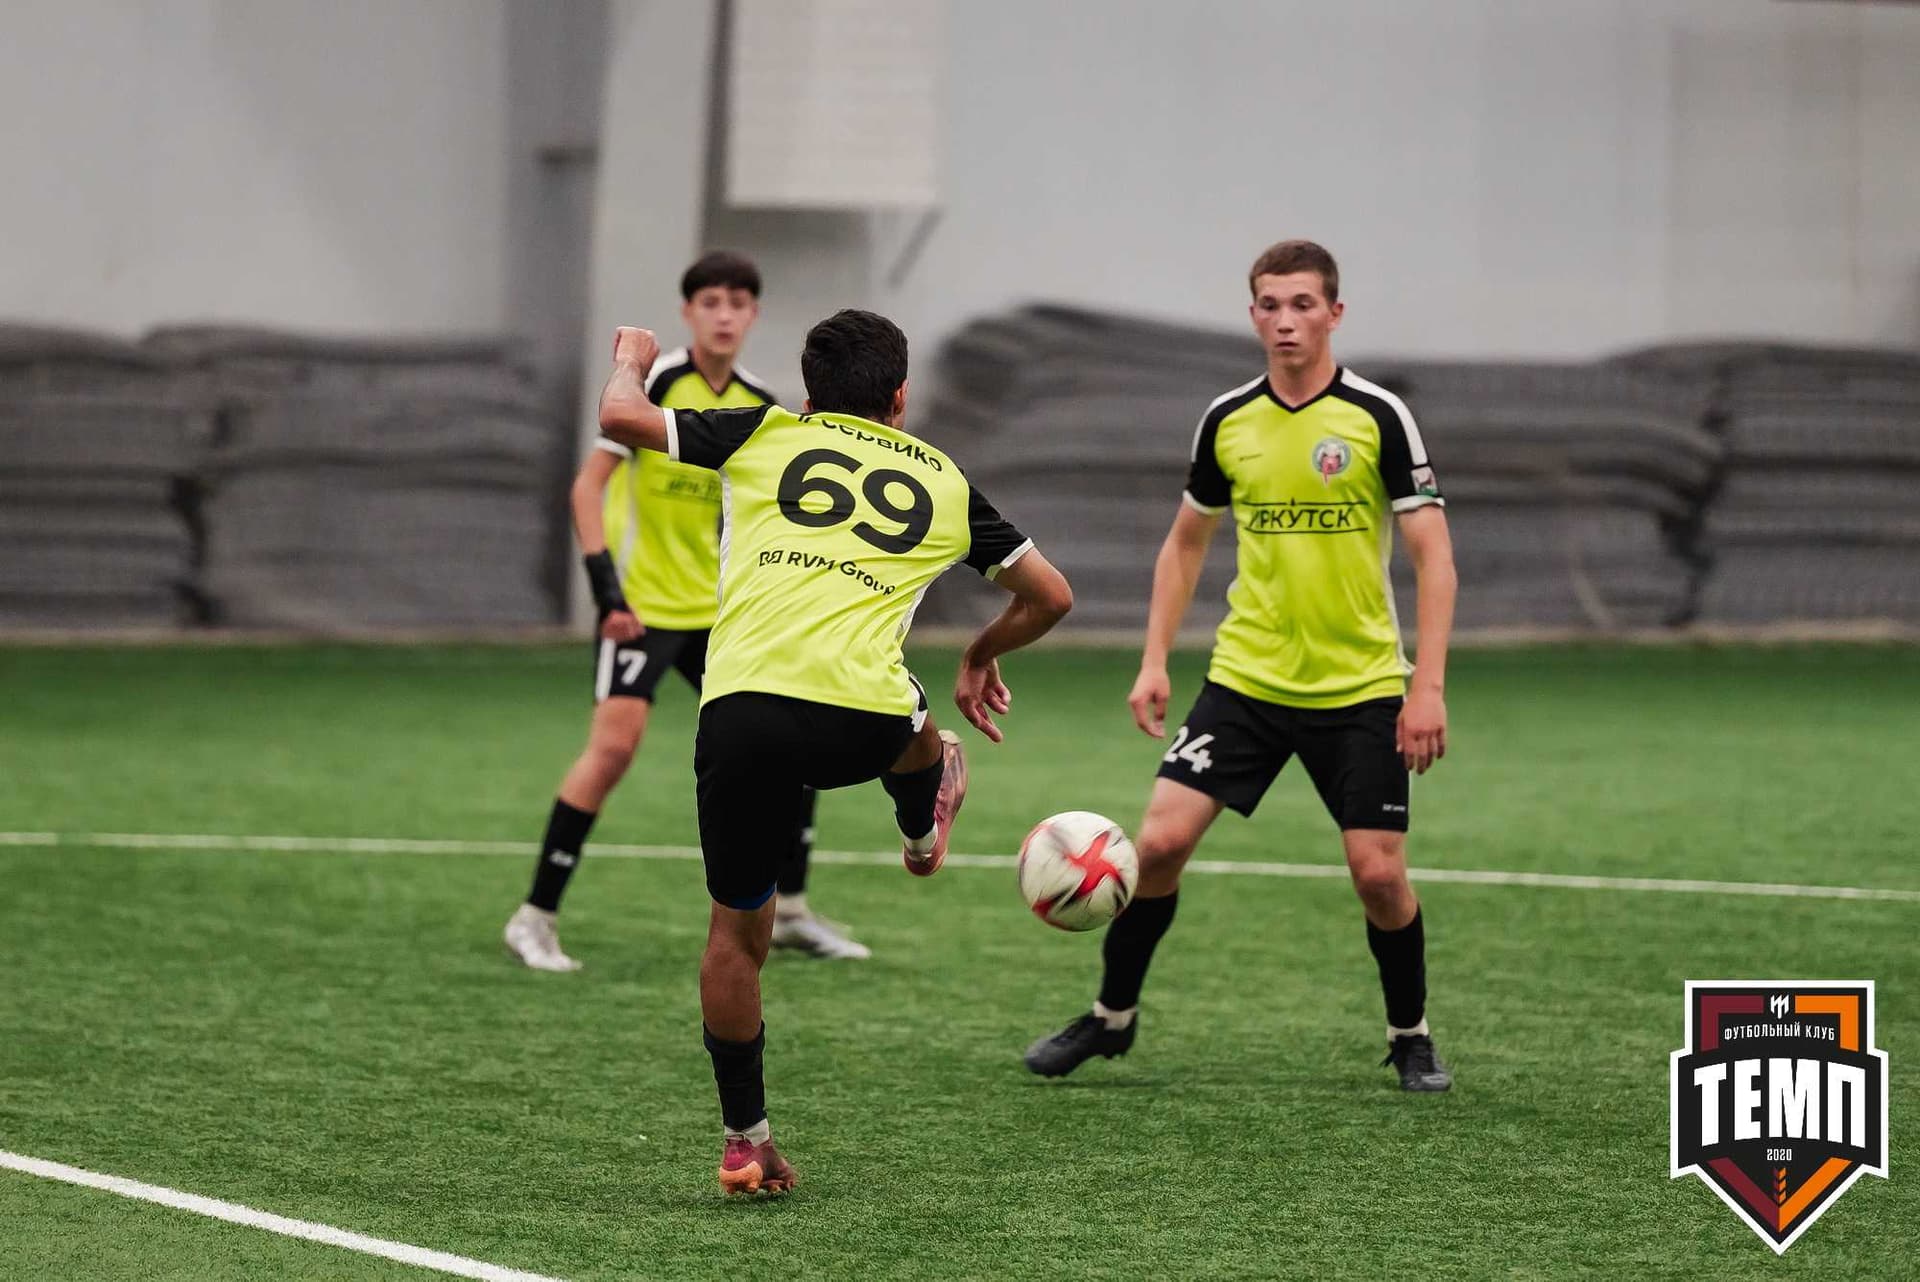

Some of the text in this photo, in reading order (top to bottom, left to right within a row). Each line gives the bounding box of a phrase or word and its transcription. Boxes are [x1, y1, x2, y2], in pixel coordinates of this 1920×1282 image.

[777, 448, 934, 555] 69
[786, 551, 896, 596] RVM Group
[1163, 726, 1215, 774] 24
